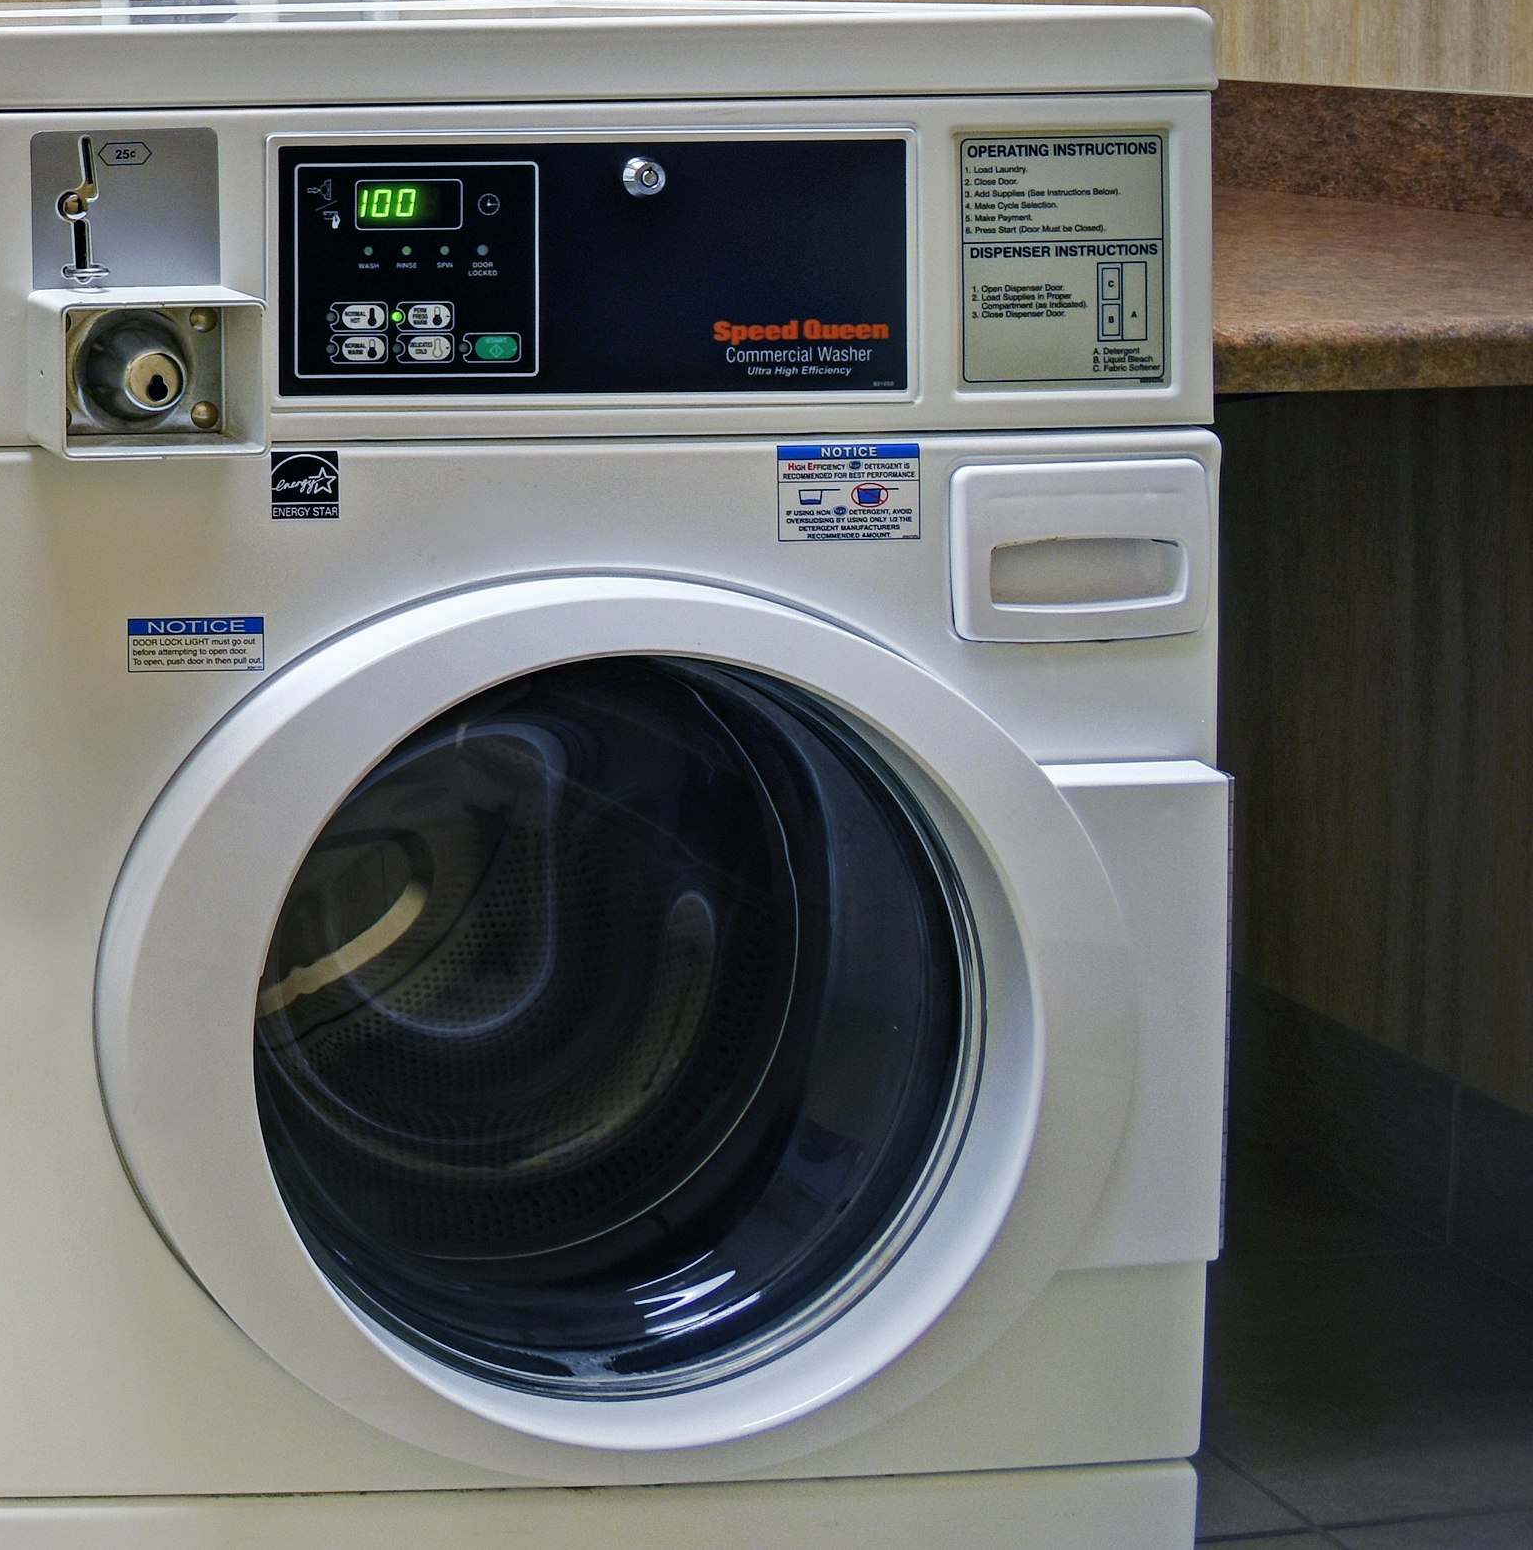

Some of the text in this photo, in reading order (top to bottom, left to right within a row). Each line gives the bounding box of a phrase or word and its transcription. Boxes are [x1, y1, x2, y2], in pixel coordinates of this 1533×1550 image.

[966, 141, 1157, 157] OPERATING INSTRUCTIONS
[963, 165, 971, 174] 1.
[994, 165, 1028, 175] Laundry.
[964, 189, 972, 198] 3.
[991, 188, 1025, 198] Supplies
[1026, 188, 1045, 198] (See
[1091, 187, 1121, 197] Below).
[360, 188, 416, 218] 100
[969, 243, 1158, 258] DISPENSER INSTRUCTIONS
[713, 319, 890, 345] Speed Queen
[725, 346, 872, 363] Commercial Washer
[746, 364, 852, 377] Ultra High Efficiency
[820, 447, 878, 458] NOTICE
[271, 505, 339, 517] ENERGY STAR
[147, 620, 246, 634] NOTICE
